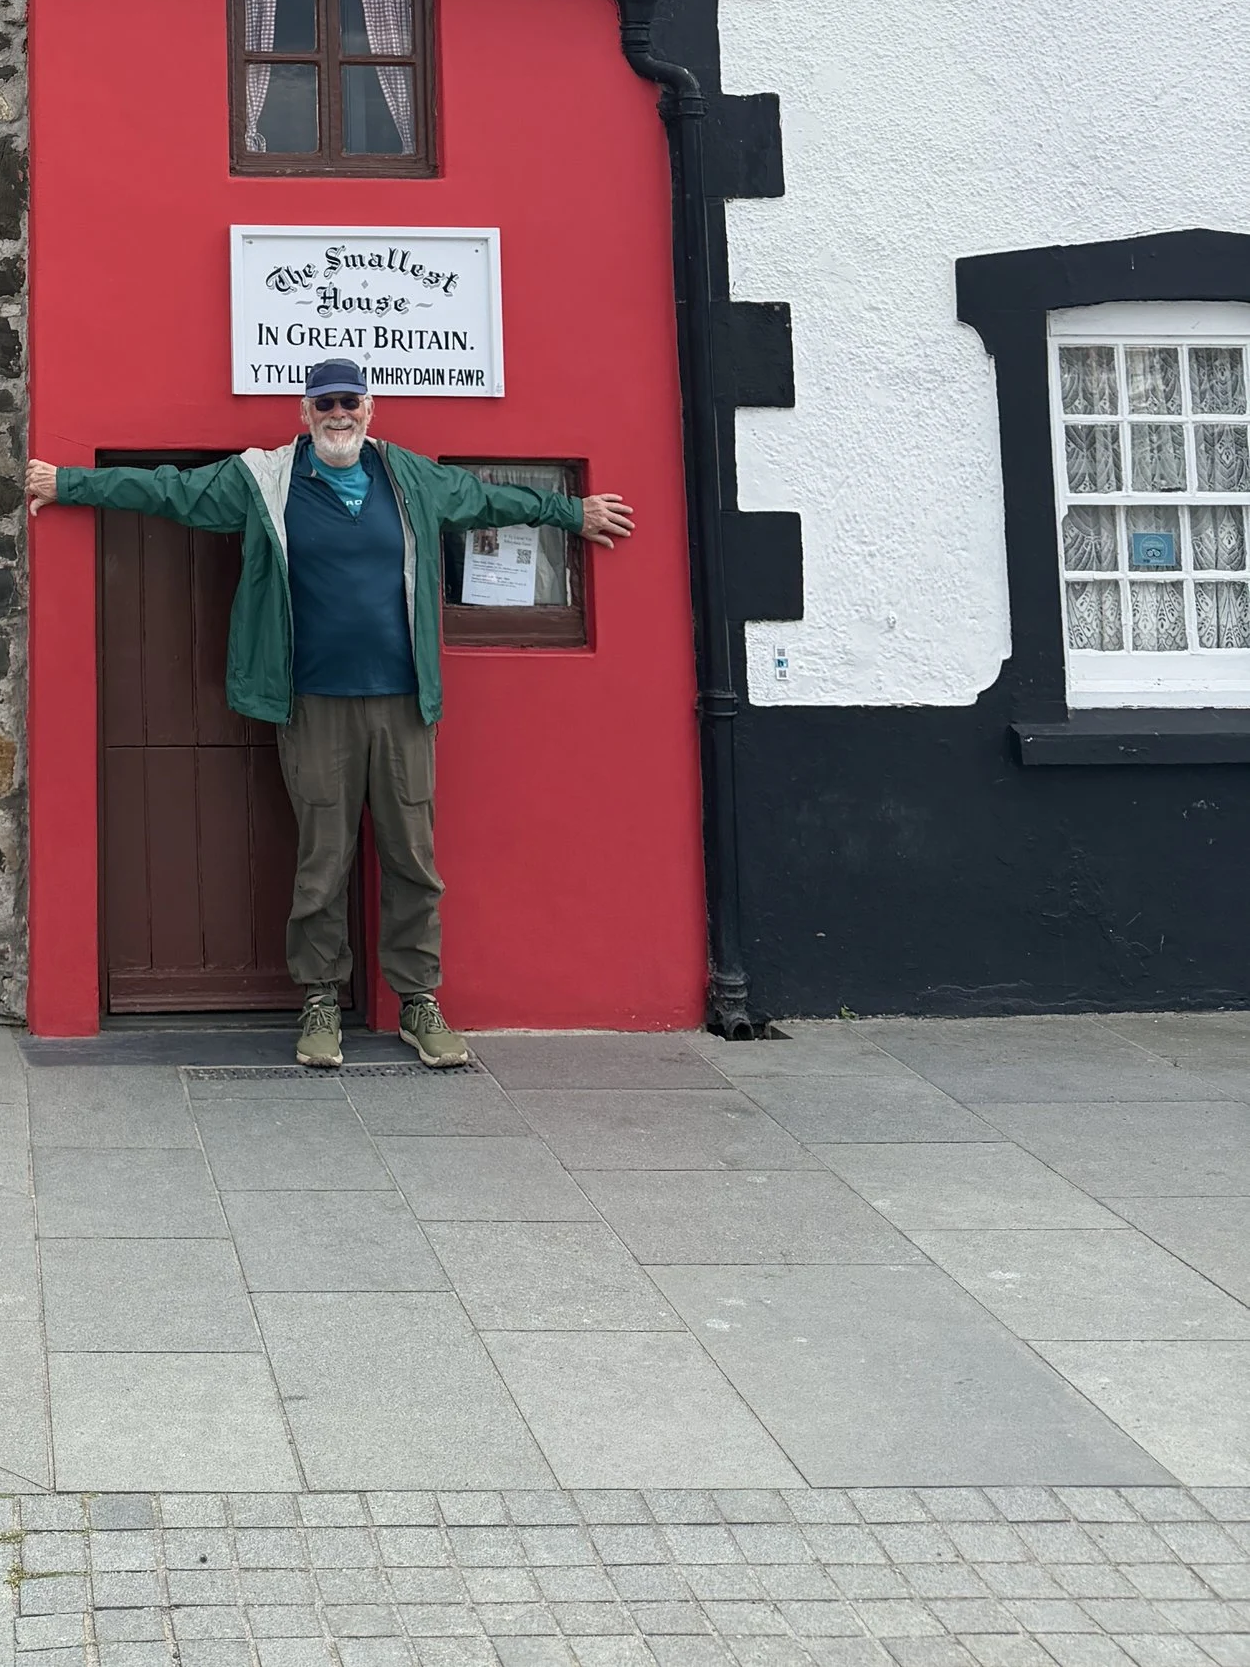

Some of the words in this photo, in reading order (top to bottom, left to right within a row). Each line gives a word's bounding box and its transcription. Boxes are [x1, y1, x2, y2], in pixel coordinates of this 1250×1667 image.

[265, 261, 318, 295] The
[323, 244, 460, 296] Smallest
[316, 282, 410, 317] House
[257, 323, 279, 346] IN
[286, 323, 367, 351] GREAT
[373, 326, 475, 352] BRITAIN.
[250, 364, 262, 383] Y
[264, 364, 286, 384] TY
[372, 366, 445, 386] MHRYDAIN
[449, 369, 486, 387] FAWR
